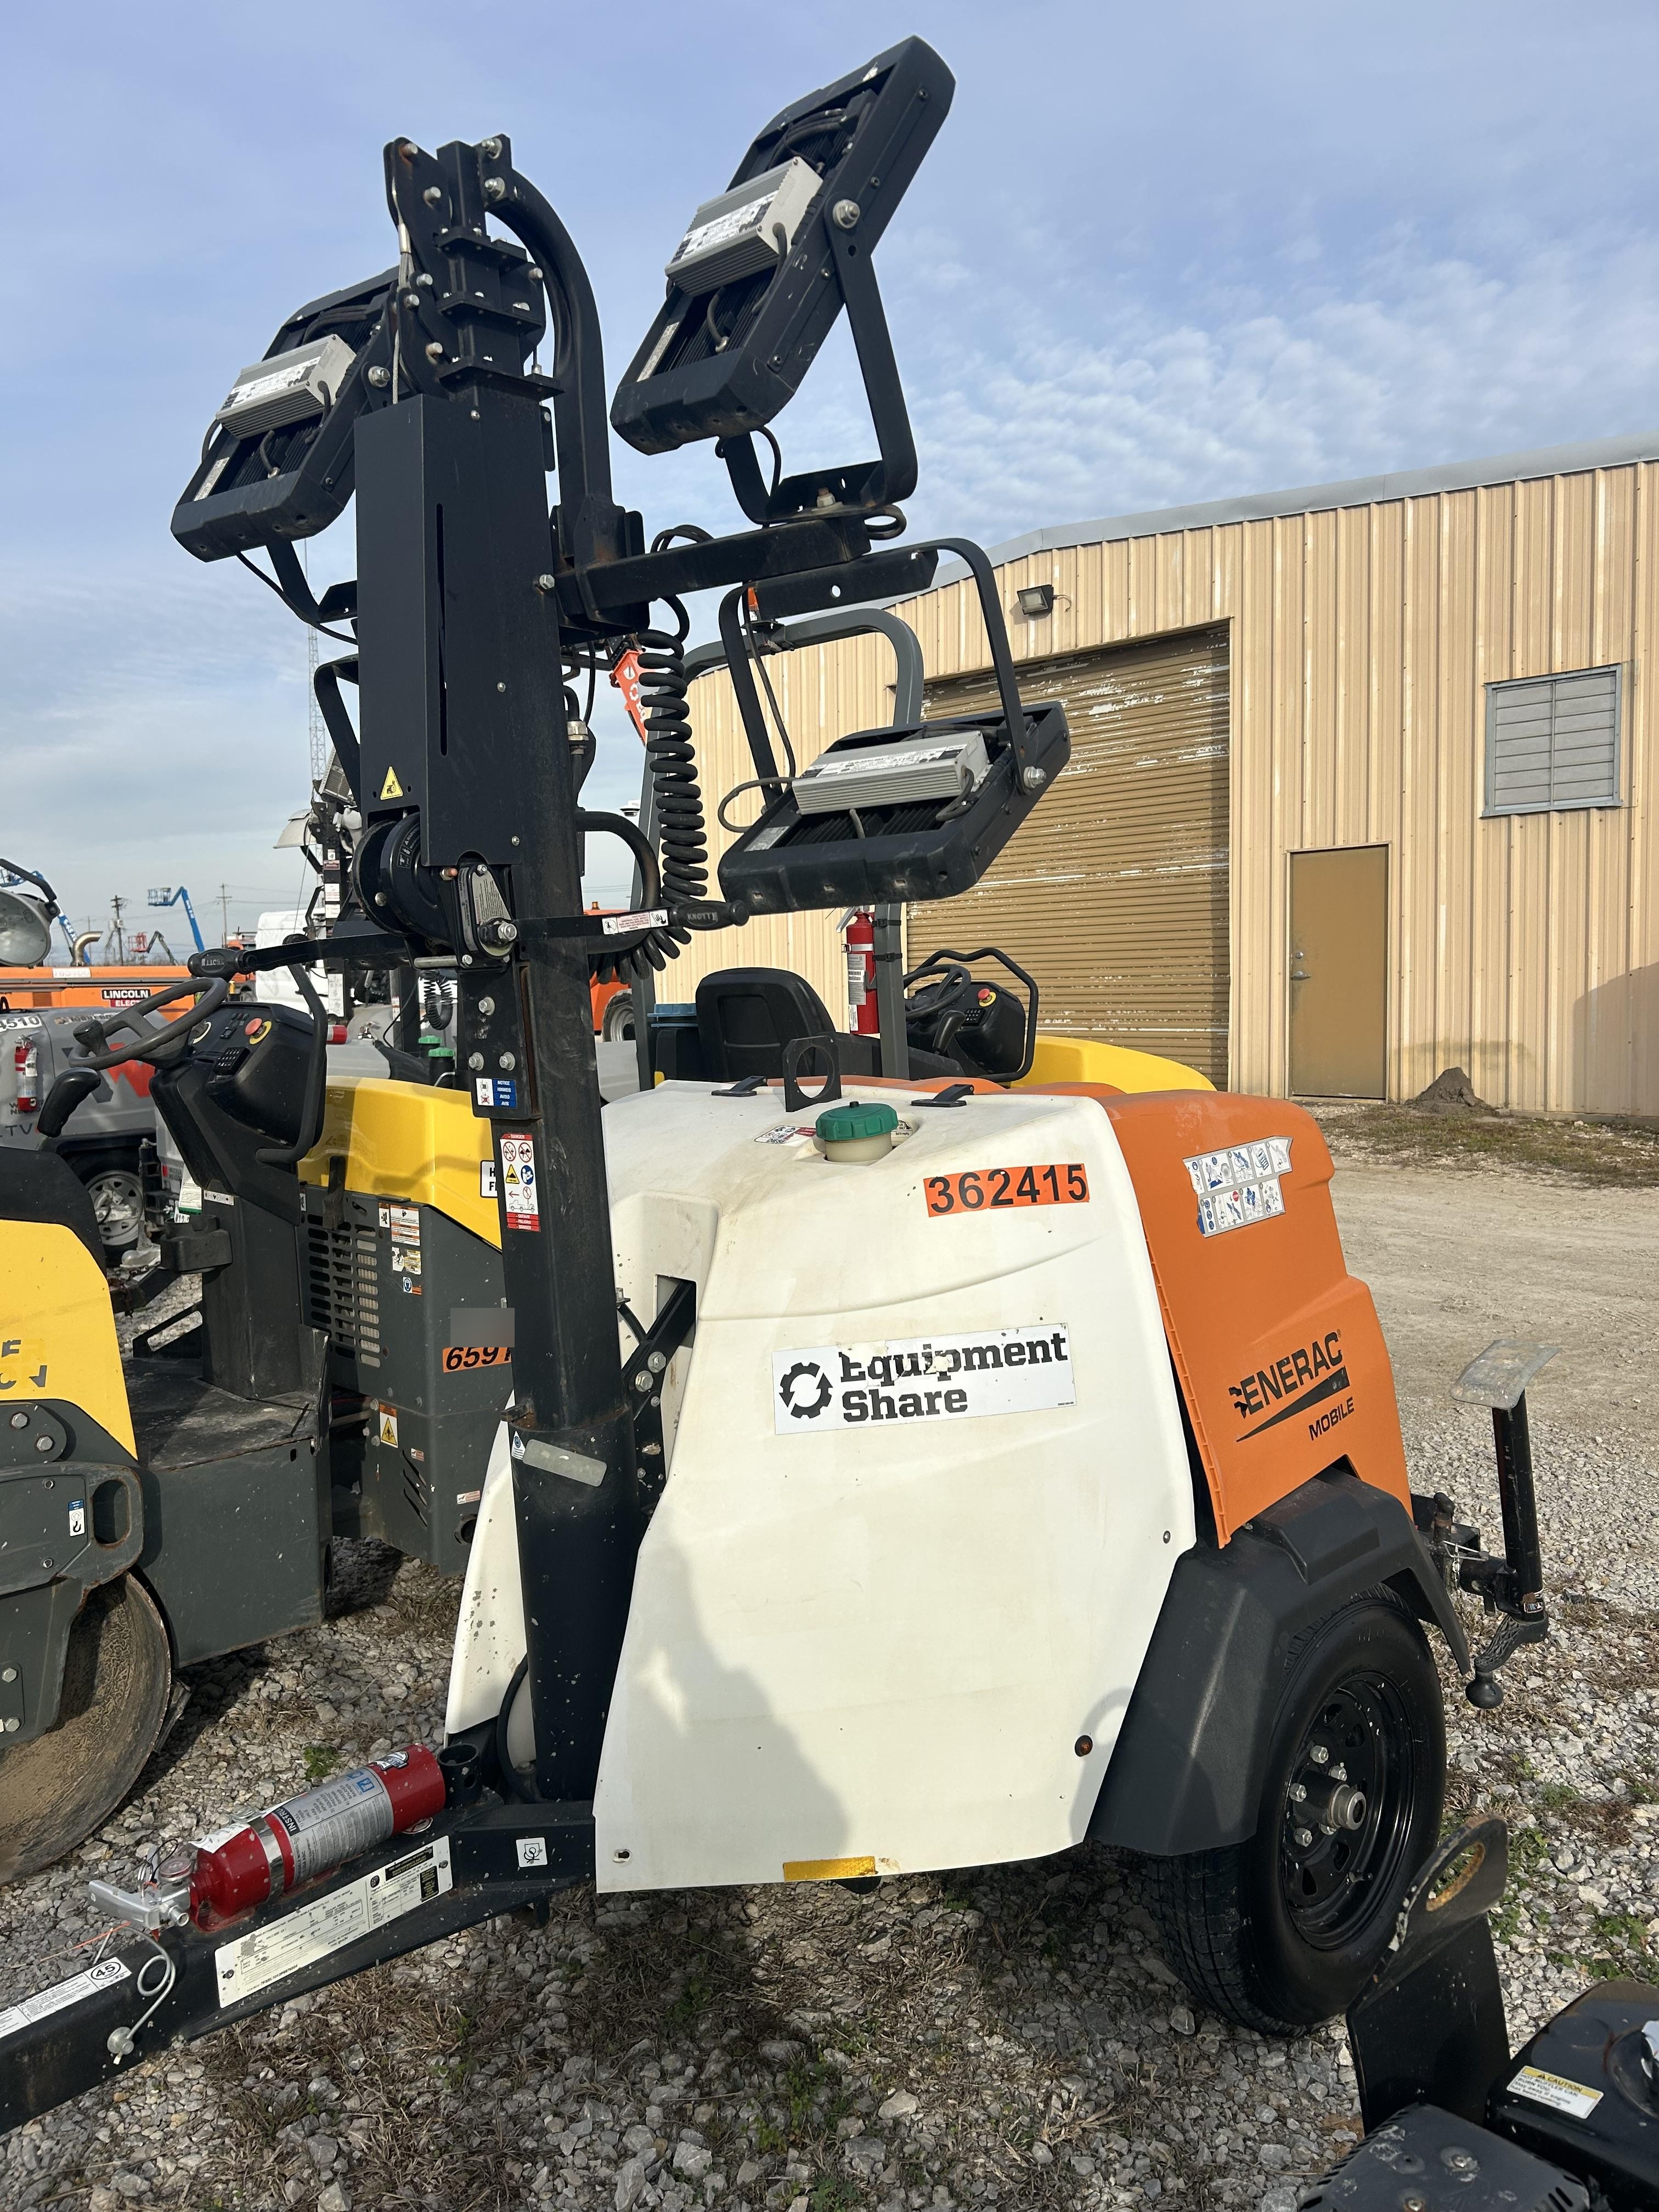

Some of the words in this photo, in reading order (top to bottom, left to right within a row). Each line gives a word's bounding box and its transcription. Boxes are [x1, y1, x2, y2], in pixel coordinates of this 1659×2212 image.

[104, 990, 149, 998] LINCOLN
[928, 1165, 1086, 1213] 362415
[838, 1333, 1068, 1386] Equipment
[842, 1389, 968, 1423] Share
[1308, 1396, 1355, 1441] MOBILE
[96, 1964, 115, 1977] 45
[1548, 2076, 1583, 2092] CAUTION
